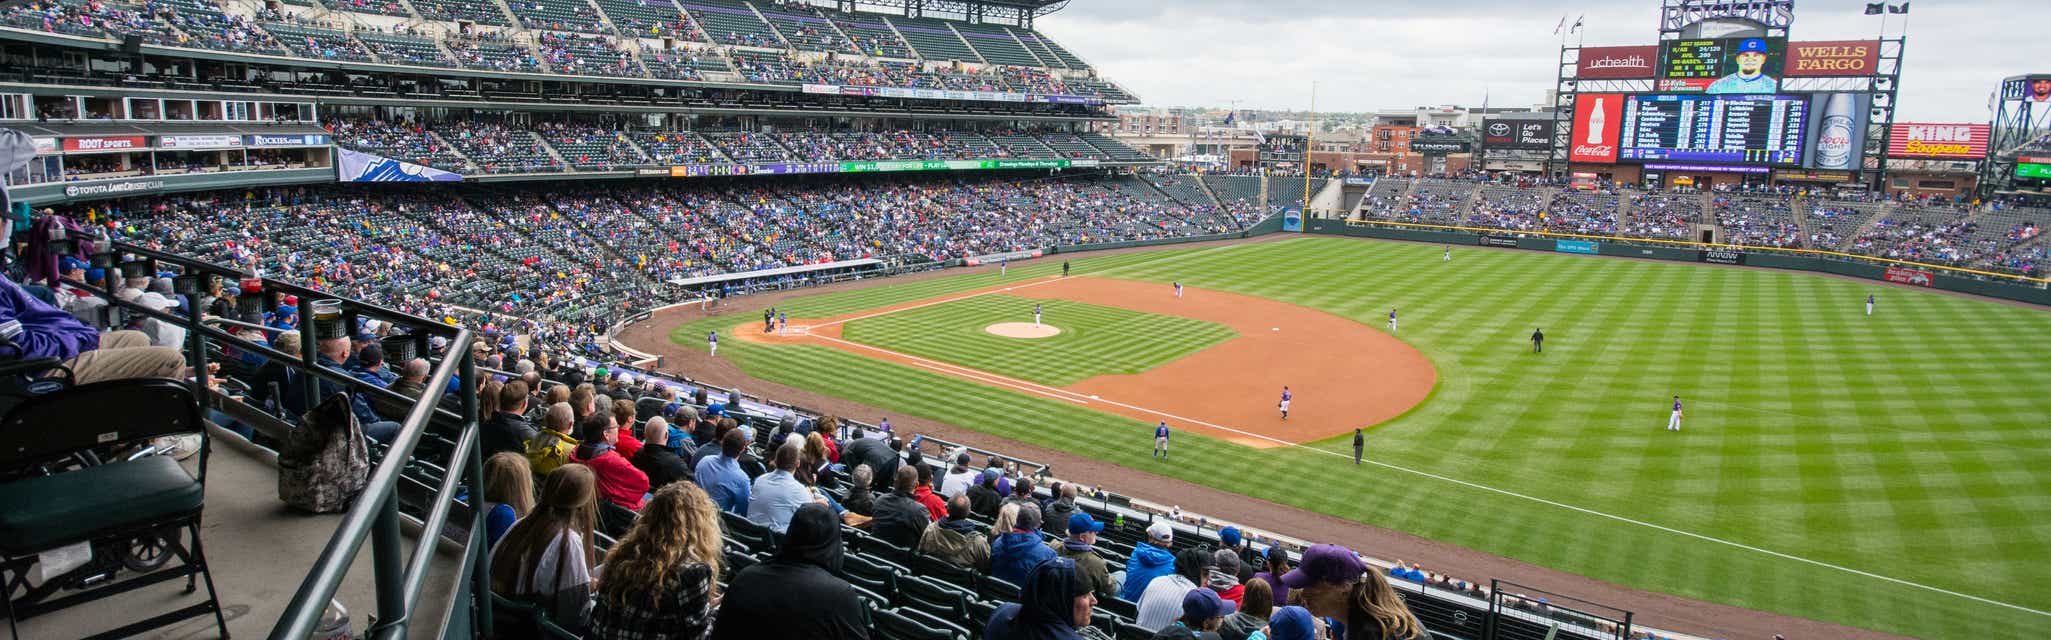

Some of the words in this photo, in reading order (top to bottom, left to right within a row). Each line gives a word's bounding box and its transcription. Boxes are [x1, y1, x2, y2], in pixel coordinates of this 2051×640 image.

[1798, 46, 1868, 58] WELLS
[1590, 55, 1645, 68] uchealth
[1796, 58, 1865, 70] FARGO
[1523, 123, 1542, 131] Let's
[1907, 125, 1972, 141] KING
[78, 139, 103, 149] ROOT
[103, 140, 132, 148] SPORTS
[1574, 144, 1613, 156] Coca-Cola
[1904, 139, 1971, 156] Soopers
[79, 185, 108, 195] TOYOTA
[147, 180, 164, 189] CLUB
